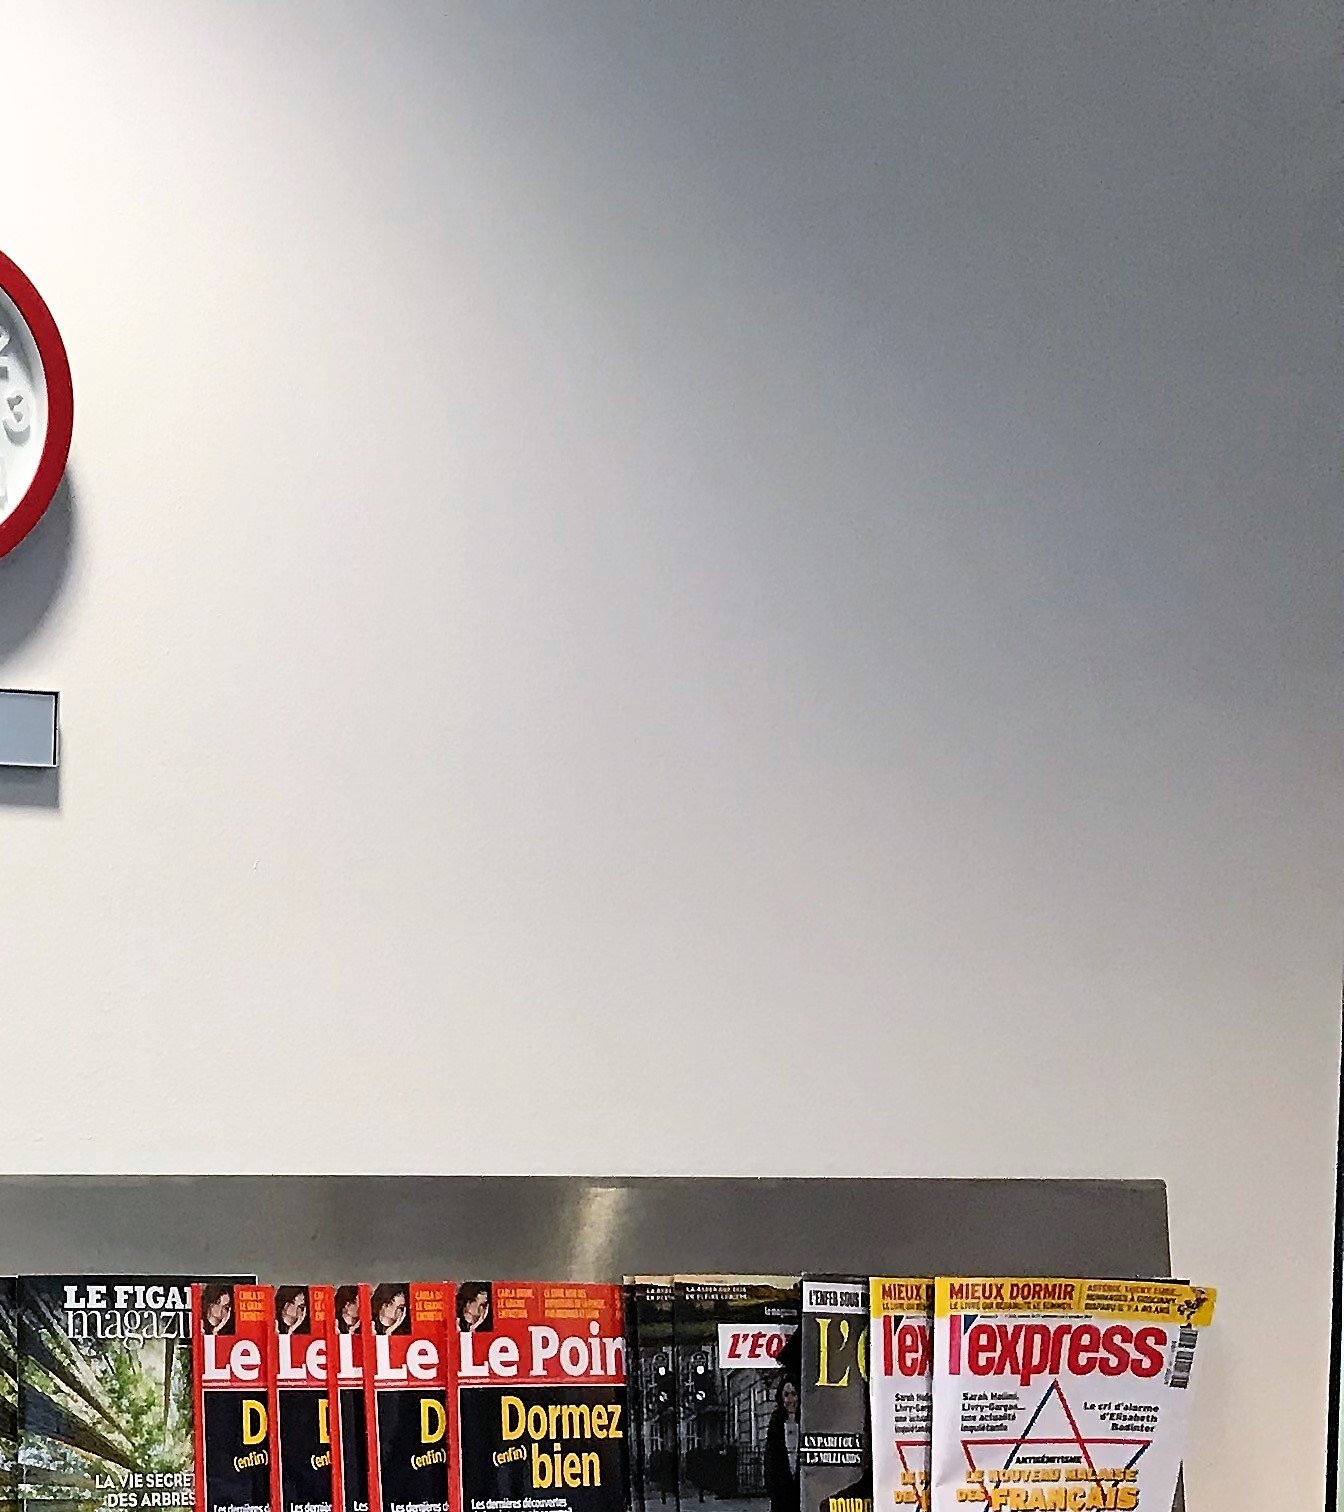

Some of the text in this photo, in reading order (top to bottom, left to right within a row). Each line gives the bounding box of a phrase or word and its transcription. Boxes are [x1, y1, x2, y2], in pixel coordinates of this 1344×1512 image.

[63, 1285, 107, 1309] LE
[949, 1283, 1004, 1301] MIEUX
[1009, 1283, 1075, 1301] DORMIR
[203, 1335, 261, 1379] Le
[374, 1335, 439, 1379] Le
[458, 1334, 519, 1378] Le
[501, 1396, 623, 1441] Dormez
[95, 1473, 143, 1489] LA VIE
[492, 1445, 600, 1488] (enfin) bien
[108, 1491, 196, 1507] DES ARBRES
